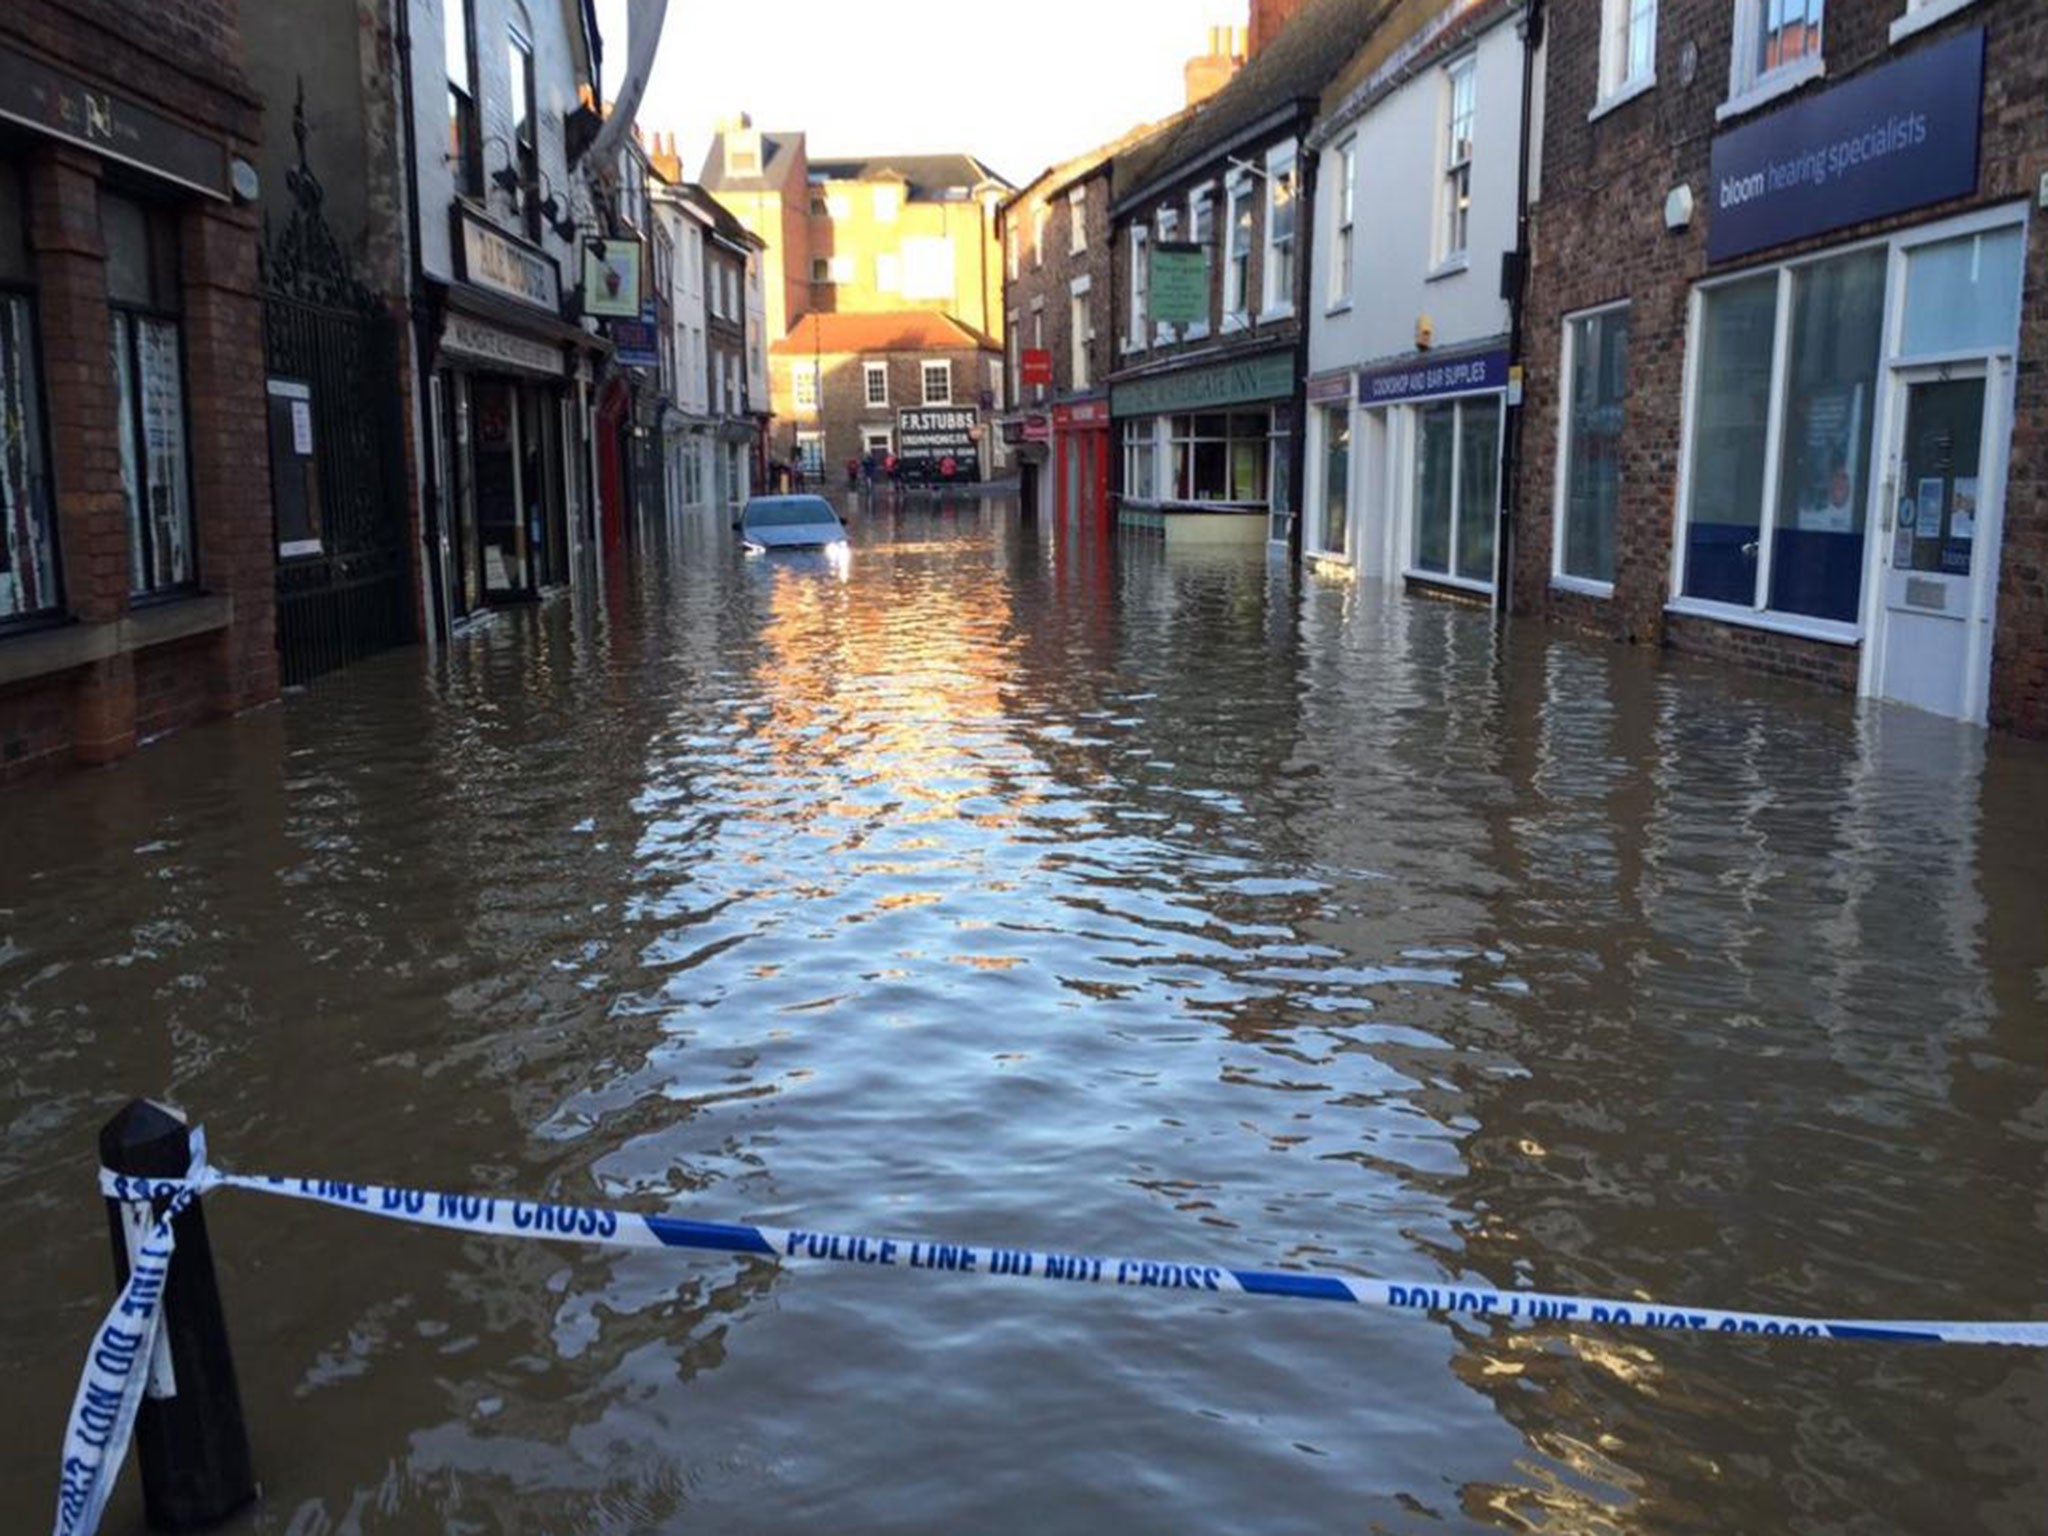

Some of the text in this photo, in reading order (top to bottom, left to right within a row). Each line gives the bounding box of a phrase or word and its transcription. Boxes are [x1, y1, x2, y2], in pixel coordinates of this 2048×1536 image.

[1719, 110, 1926, 209] bloom hearing specialists
[1372, 373, 1409, 397] COOKSHOP
[1410, 370, 1425, 394] AND
[1427, 367, 1444, 389] BAR
[1445, 361, 1486, 387] SUPPLIES
[382, 1187, 424, 1214] DO
[438, 1193, 496, 1223] NOT
[512, 1200, 617, 1238] CROSS
[786, 1231, 1221, 1291] POLICE LINE DO NOT CROSS
[1388, 1285, 1498, 1314] POLICE
[95, 1326, 143, 1376] DO
[76, 1380, 124, 1451] NOT
